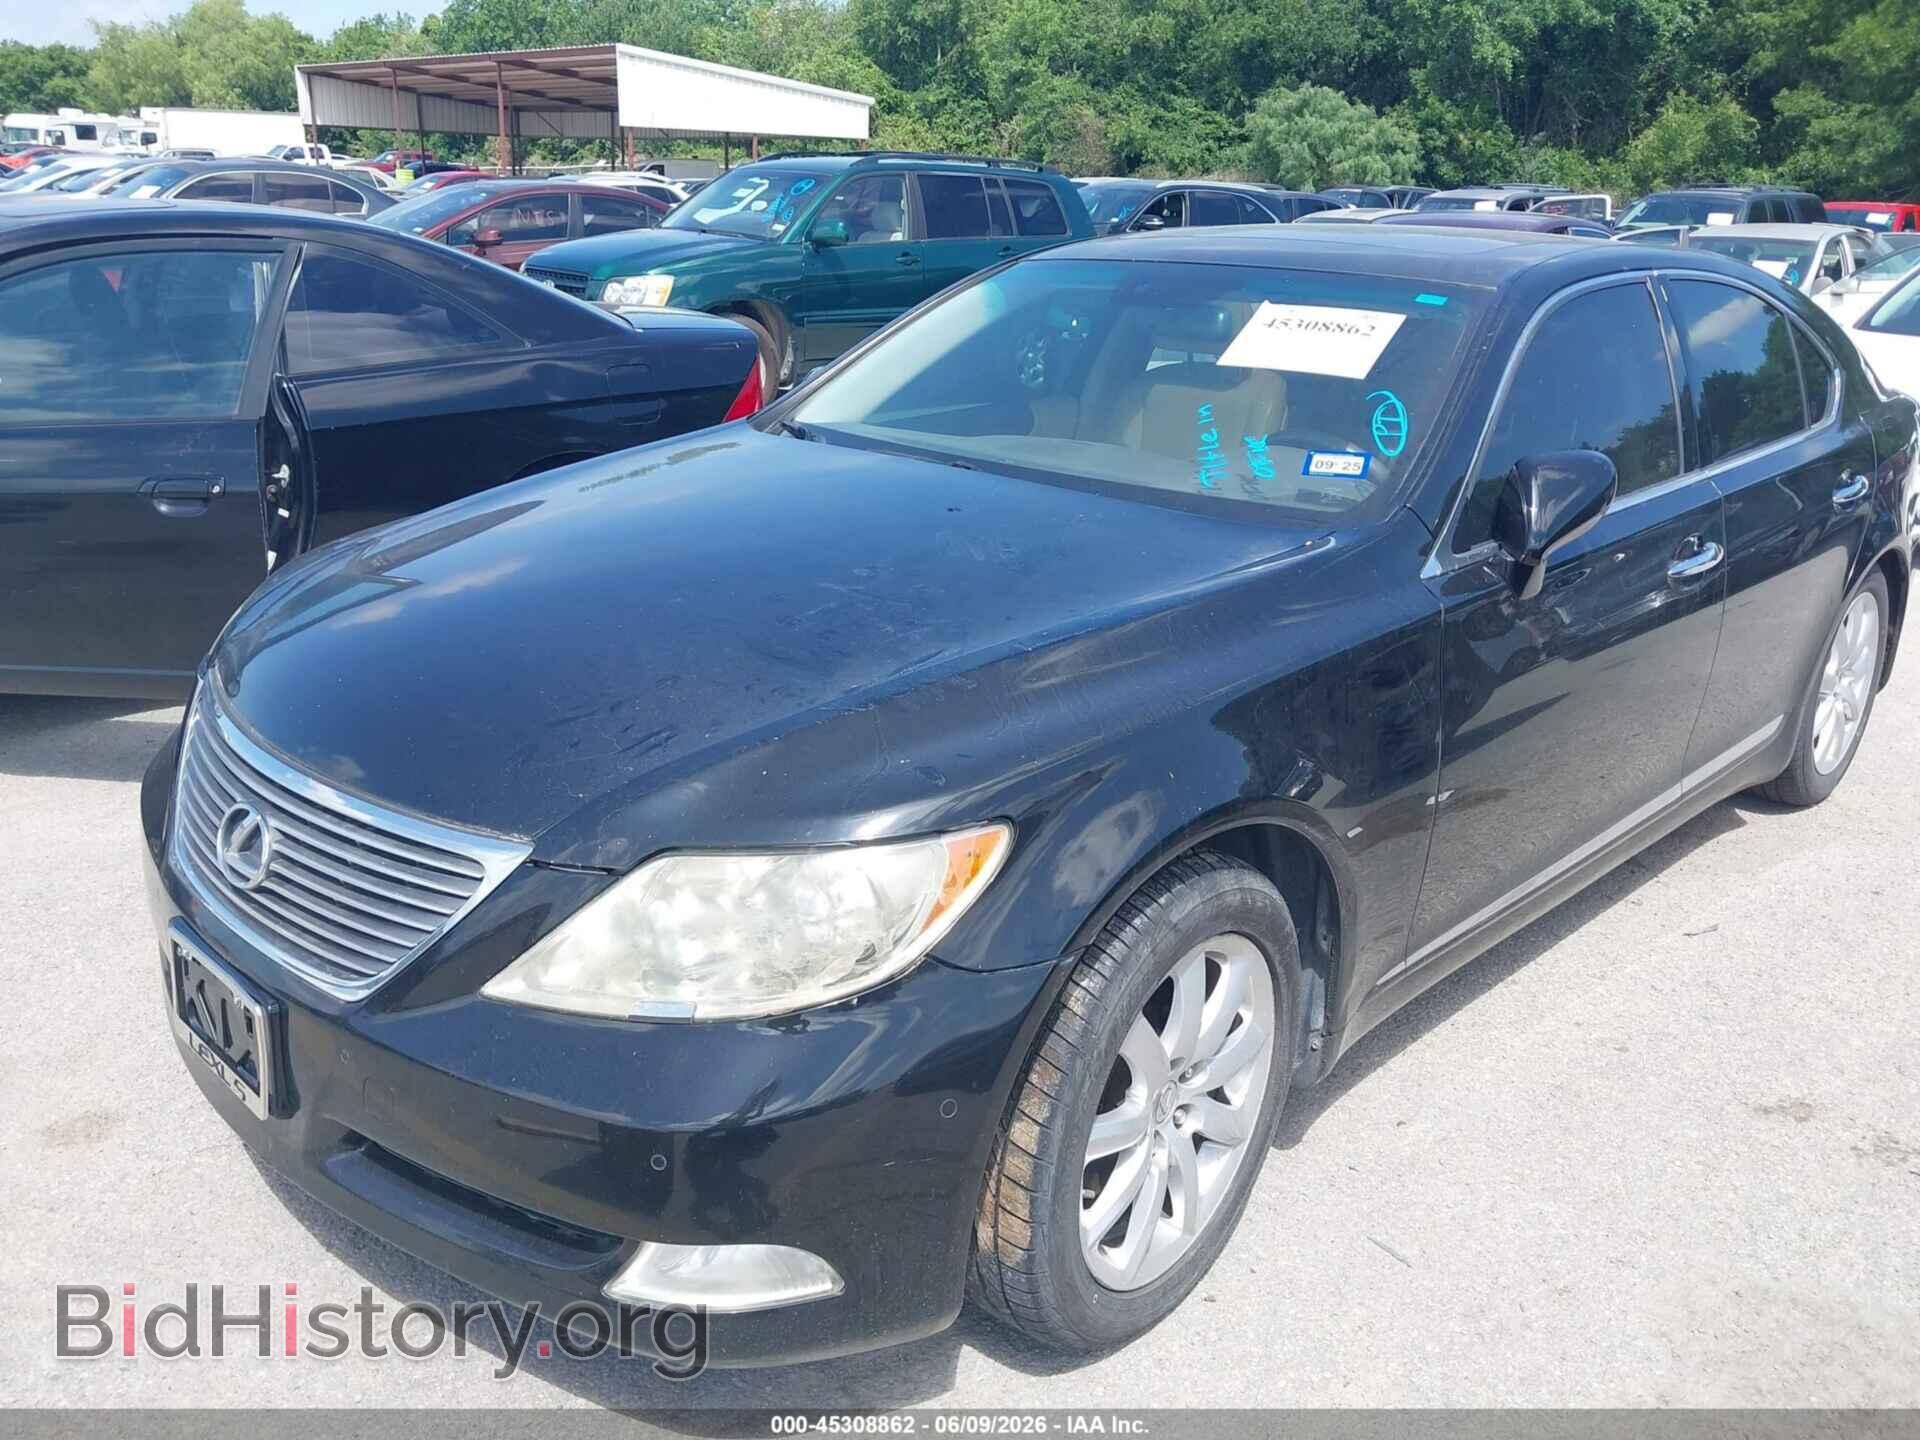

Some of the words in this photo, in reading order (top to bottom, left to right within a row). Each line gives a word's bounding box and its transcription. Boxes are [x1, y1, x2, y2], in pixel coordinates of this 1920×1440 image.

[1263, 317, 1376, 337] 45308862
[1314, 459, 1335, 471] 09
[1341, 460, 1362, 472] 25
